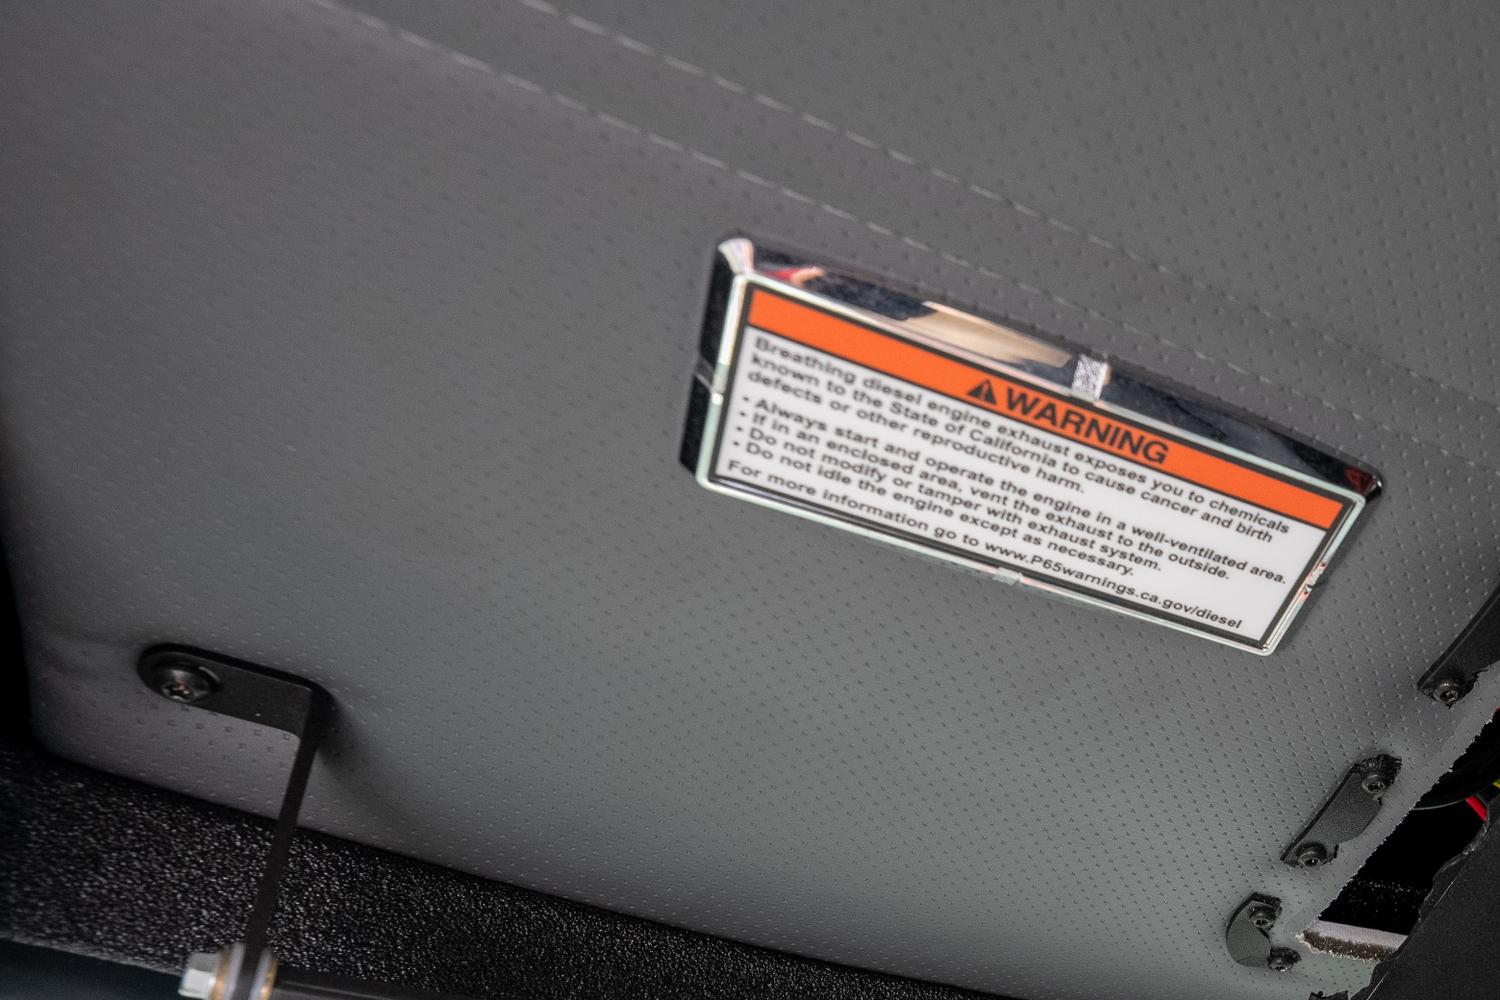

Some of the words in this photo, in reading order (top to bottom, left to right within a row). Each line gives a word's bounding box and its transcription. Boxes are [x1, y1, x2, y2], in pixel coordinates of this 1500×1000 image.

[745, 441, 774, 459] Do
[779, 455, 812, 473] not
[816, 465, 852, 485] idle
[857, 478, 887, 496] the
[891, 491, 954, 517] engine
[958, 513, 1018, 538] except
[1021, 533, 1042, 546] as
[1046, 541, 1133, 576] necessary.
[747, 371, 822, 404] defects
[828, 400, 850, 412] or
[855, 409, 907, 431] other
[912, 427, 1030, 474] reproductive
[1035, 466, 1083, 493] harm.
[748, 426, 777, 446] Do
[782, 441, 815, 459] not
[820, 453, 887, 483] modify
[891, 476, 912, 488] or
[917, 483, 982, 511] tamper
[986, 506, 1022, 525] with
[1027, 520, 1096, 549] exhaust
[1098, 544, 1161, 571] system.
[751, 353, 819, 386] known
[826, 380, 846, 395] to
[852, 389, 883, 408] the
[889, 401, 938, 427] State
[944, 422, 965, 435] of
[968, 428, 1057, 467] California
[1061, 461, 1080, 475] to
[1084, 471, 1136, 495] cause
[1139, 490, 1198, 516] cancer
[1199, 511, 1233, 529] and
[1234, 521, 1273, 543] birth
[752, 412, 767, 425] If
[771, 419, 789, 434] in
[795, 430, 820, 444] an
[825, 440, 914, 475] enclosed
[918, 470, 962, 492] area,
[969, 486, 1008, 506] vent
[1012, 498, 1040, 516] the
[1044, 511, 1113, 541] exhaust
[1116, 533, 1134, 547] to
[1137, 540, 1164, 557] the
[1167, 552, 1229, 579] outside.
[754, 336, 856, 385] Breathing
[862, 378, 922, 405] diesel
[926, 400, 991, 431] engine
[996, 424, 1070, 457] exhaust
[1073, 451, 1147, 483] exposes
[1149, 478, 1184, 497] you
[1187, 490, 1205, 504] to
[1208, 499, 1289, 533] chemicals
[754, 398, 827, 431] Always
[834, 426, 878, 448] start
[883, 443, 920, 461] and
[924, 457, 994, 486] operate
[999, 479, 1028, 497] the
[1032, 492, 1091, 518] engine
[1095, 510, 1112, 526] in
[1115, 520, 1127, 531] a
[1131, 525, 1248, 570] well-ventilated
[1249, 565, 1285, 584] area.
[1004, 387, 1171, 466] WARNING
[727, 459, 761, 477] For
[767, 473, 816, 495] more
[822, 489, 928, 531] information
[933, 526, 957, 539] go
[961, 533, 979, 547] to
[984, 542, 1242, 628] www.P65warnings.ca.gov/diesel
